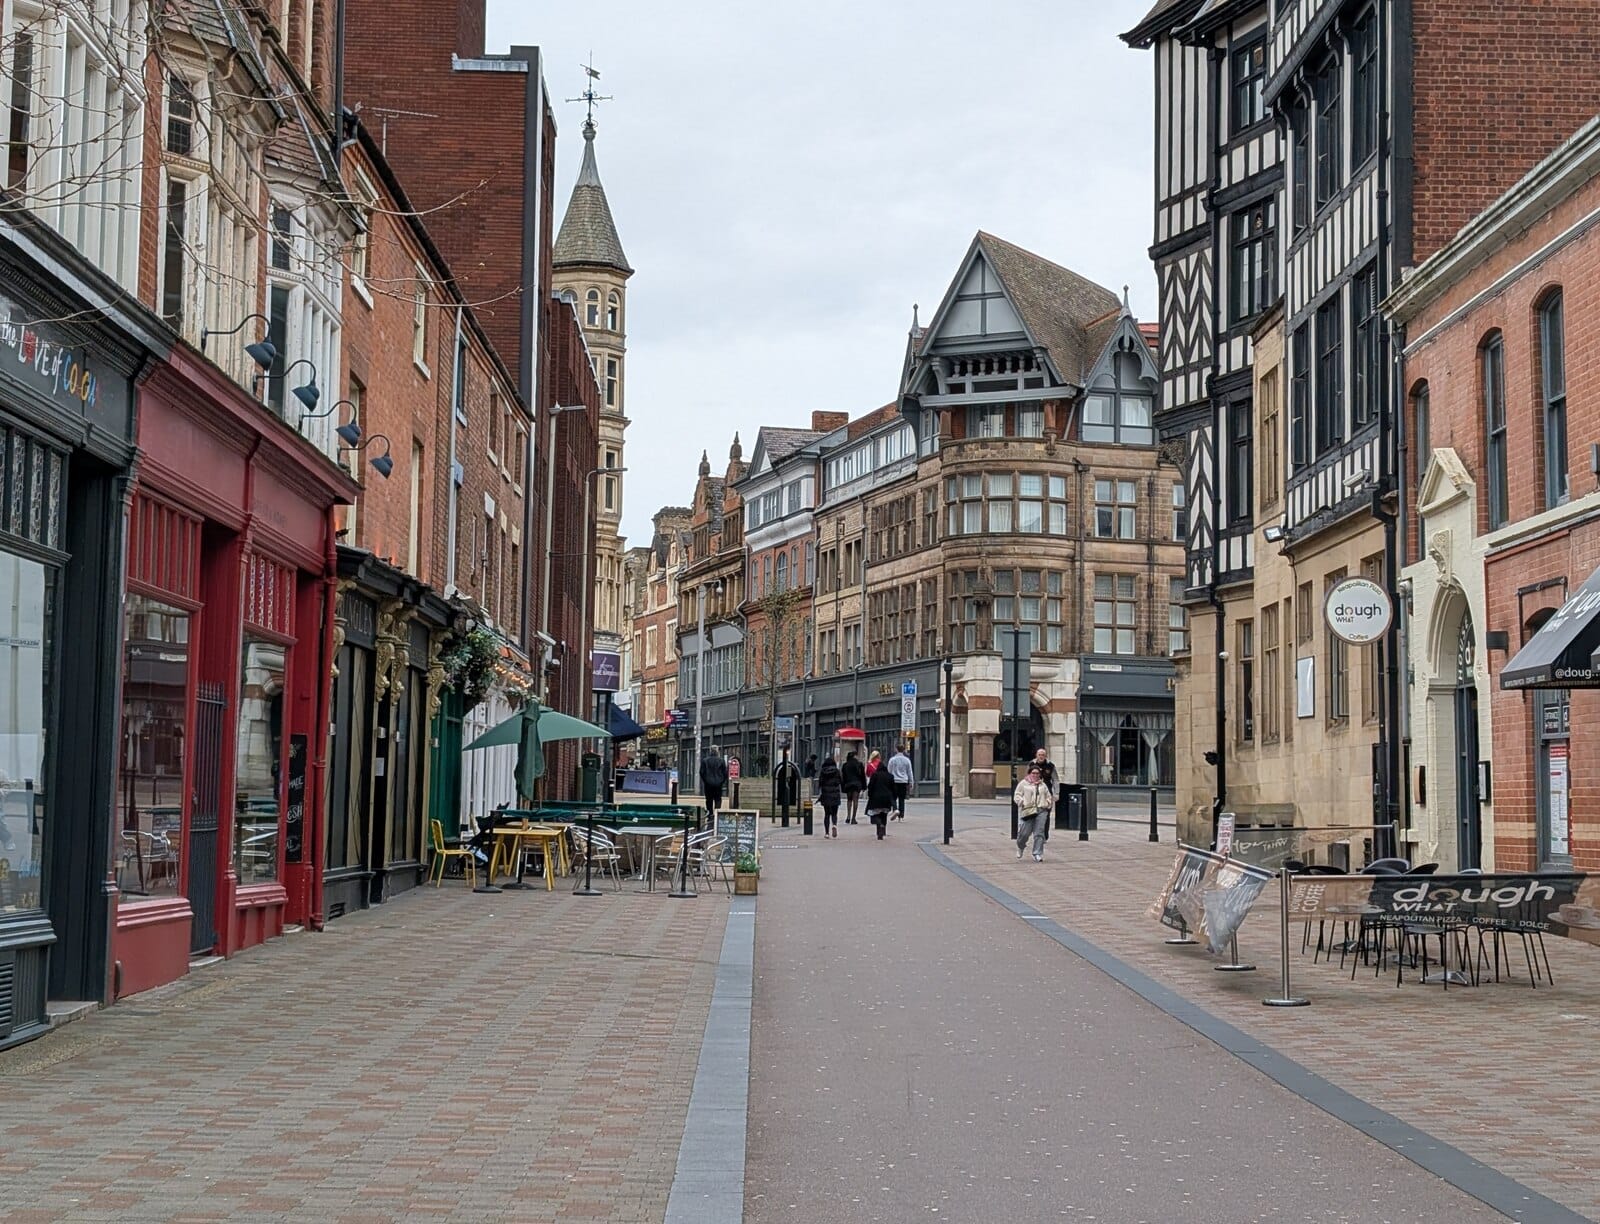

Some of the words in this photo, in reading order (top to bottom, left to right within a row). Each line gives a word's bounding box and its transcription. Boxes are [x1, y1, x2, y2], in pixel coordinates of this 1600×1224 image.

[51, 347, 63, 395] of
[1335, 603, 1382, 619] dough
[1555, 666, 1599, 680] @doug
[1302, 884, 1326, 912] COFFEE
[1393, 880, 1555, 908] dough
[1392, 902, 1458, 913] WHAT
[1380, 914, 1435, 922] NEAPOLITAN
[1437, 915, 1462, 923] PIZZA
[1472, 916, 1508, 926] COFFEE
[1520, 920, 1550, 930] DOLCE
